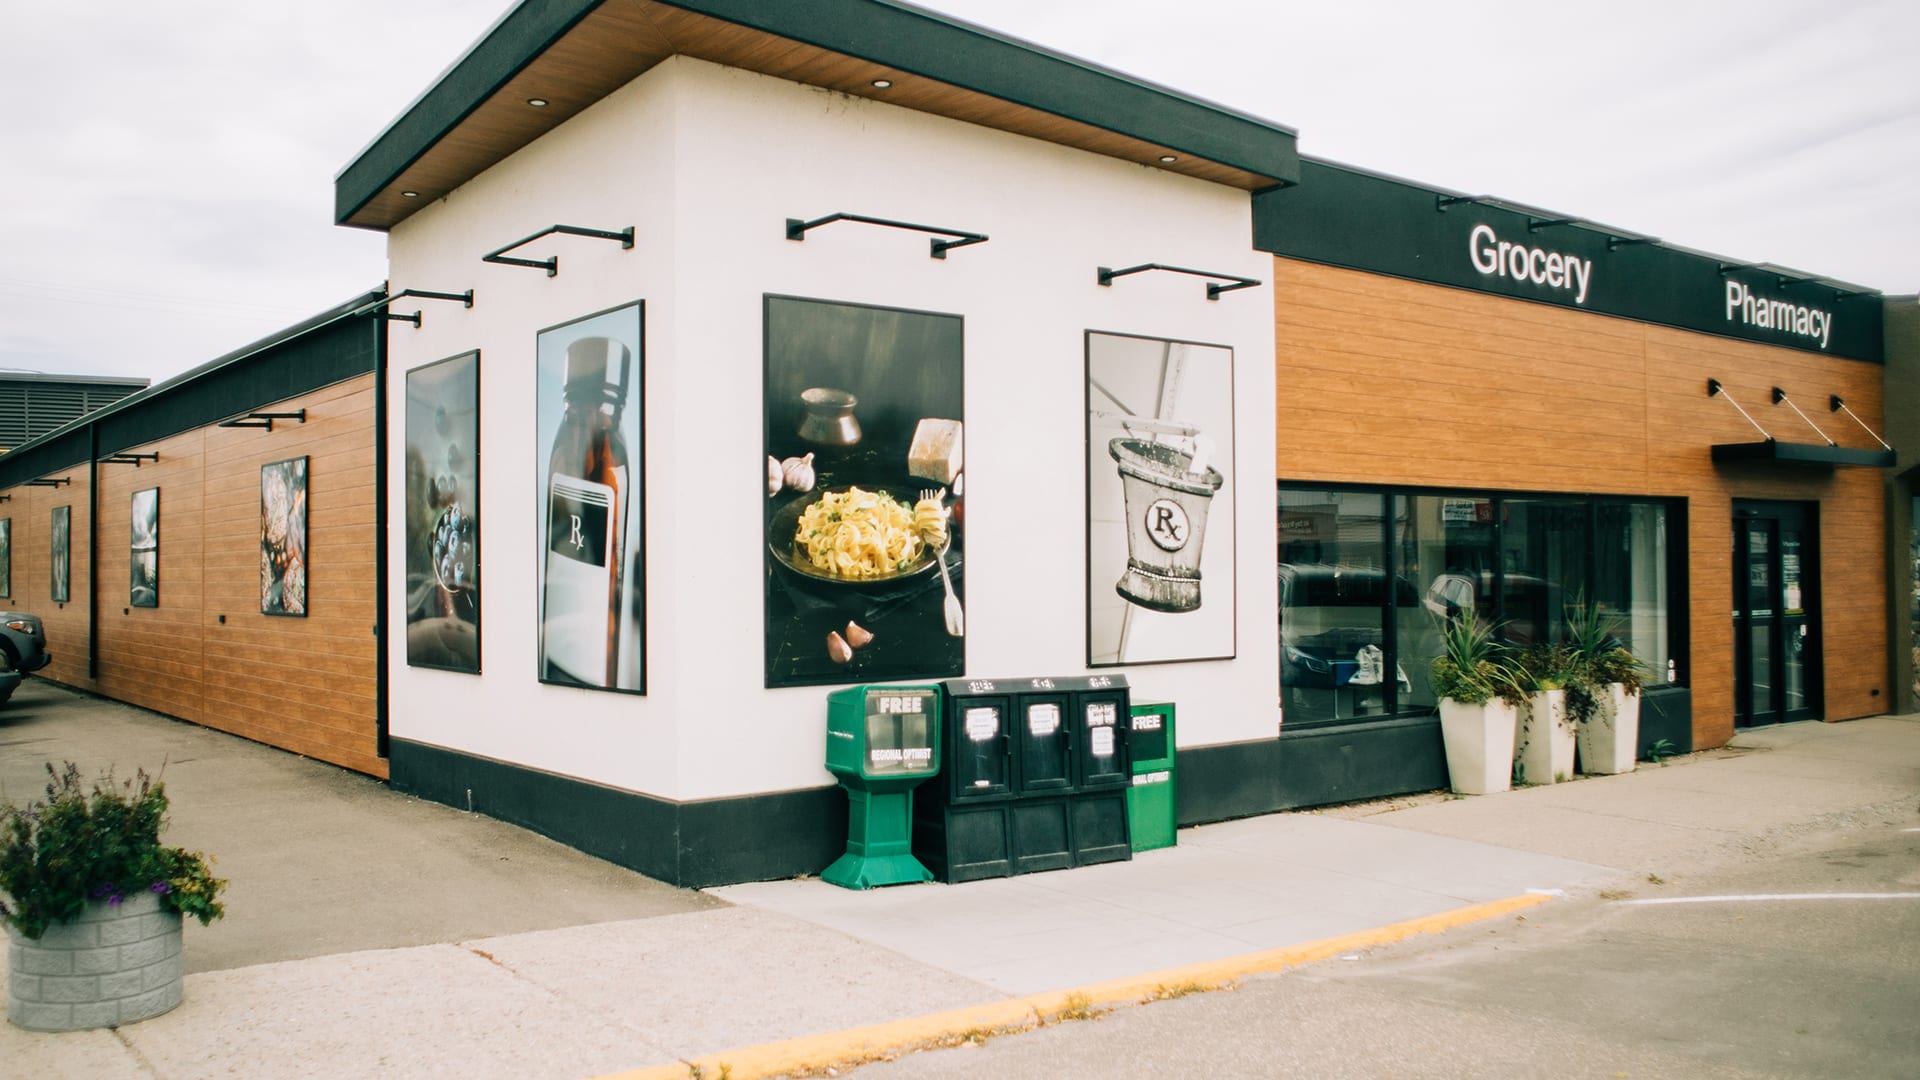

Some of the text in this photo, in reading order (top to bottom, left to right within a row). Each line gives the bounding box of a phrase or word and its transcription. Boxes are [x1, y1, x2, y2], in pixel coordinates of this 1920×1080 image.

[1469, 225, 1591, 303] Grocery
[1726, 281, 1831, 348] Pharmacy
[880, 697, 922, 713] FREE
[1132, 714, 1161, 730] FREE
[871, 749, 903, 761] REGIONAL
